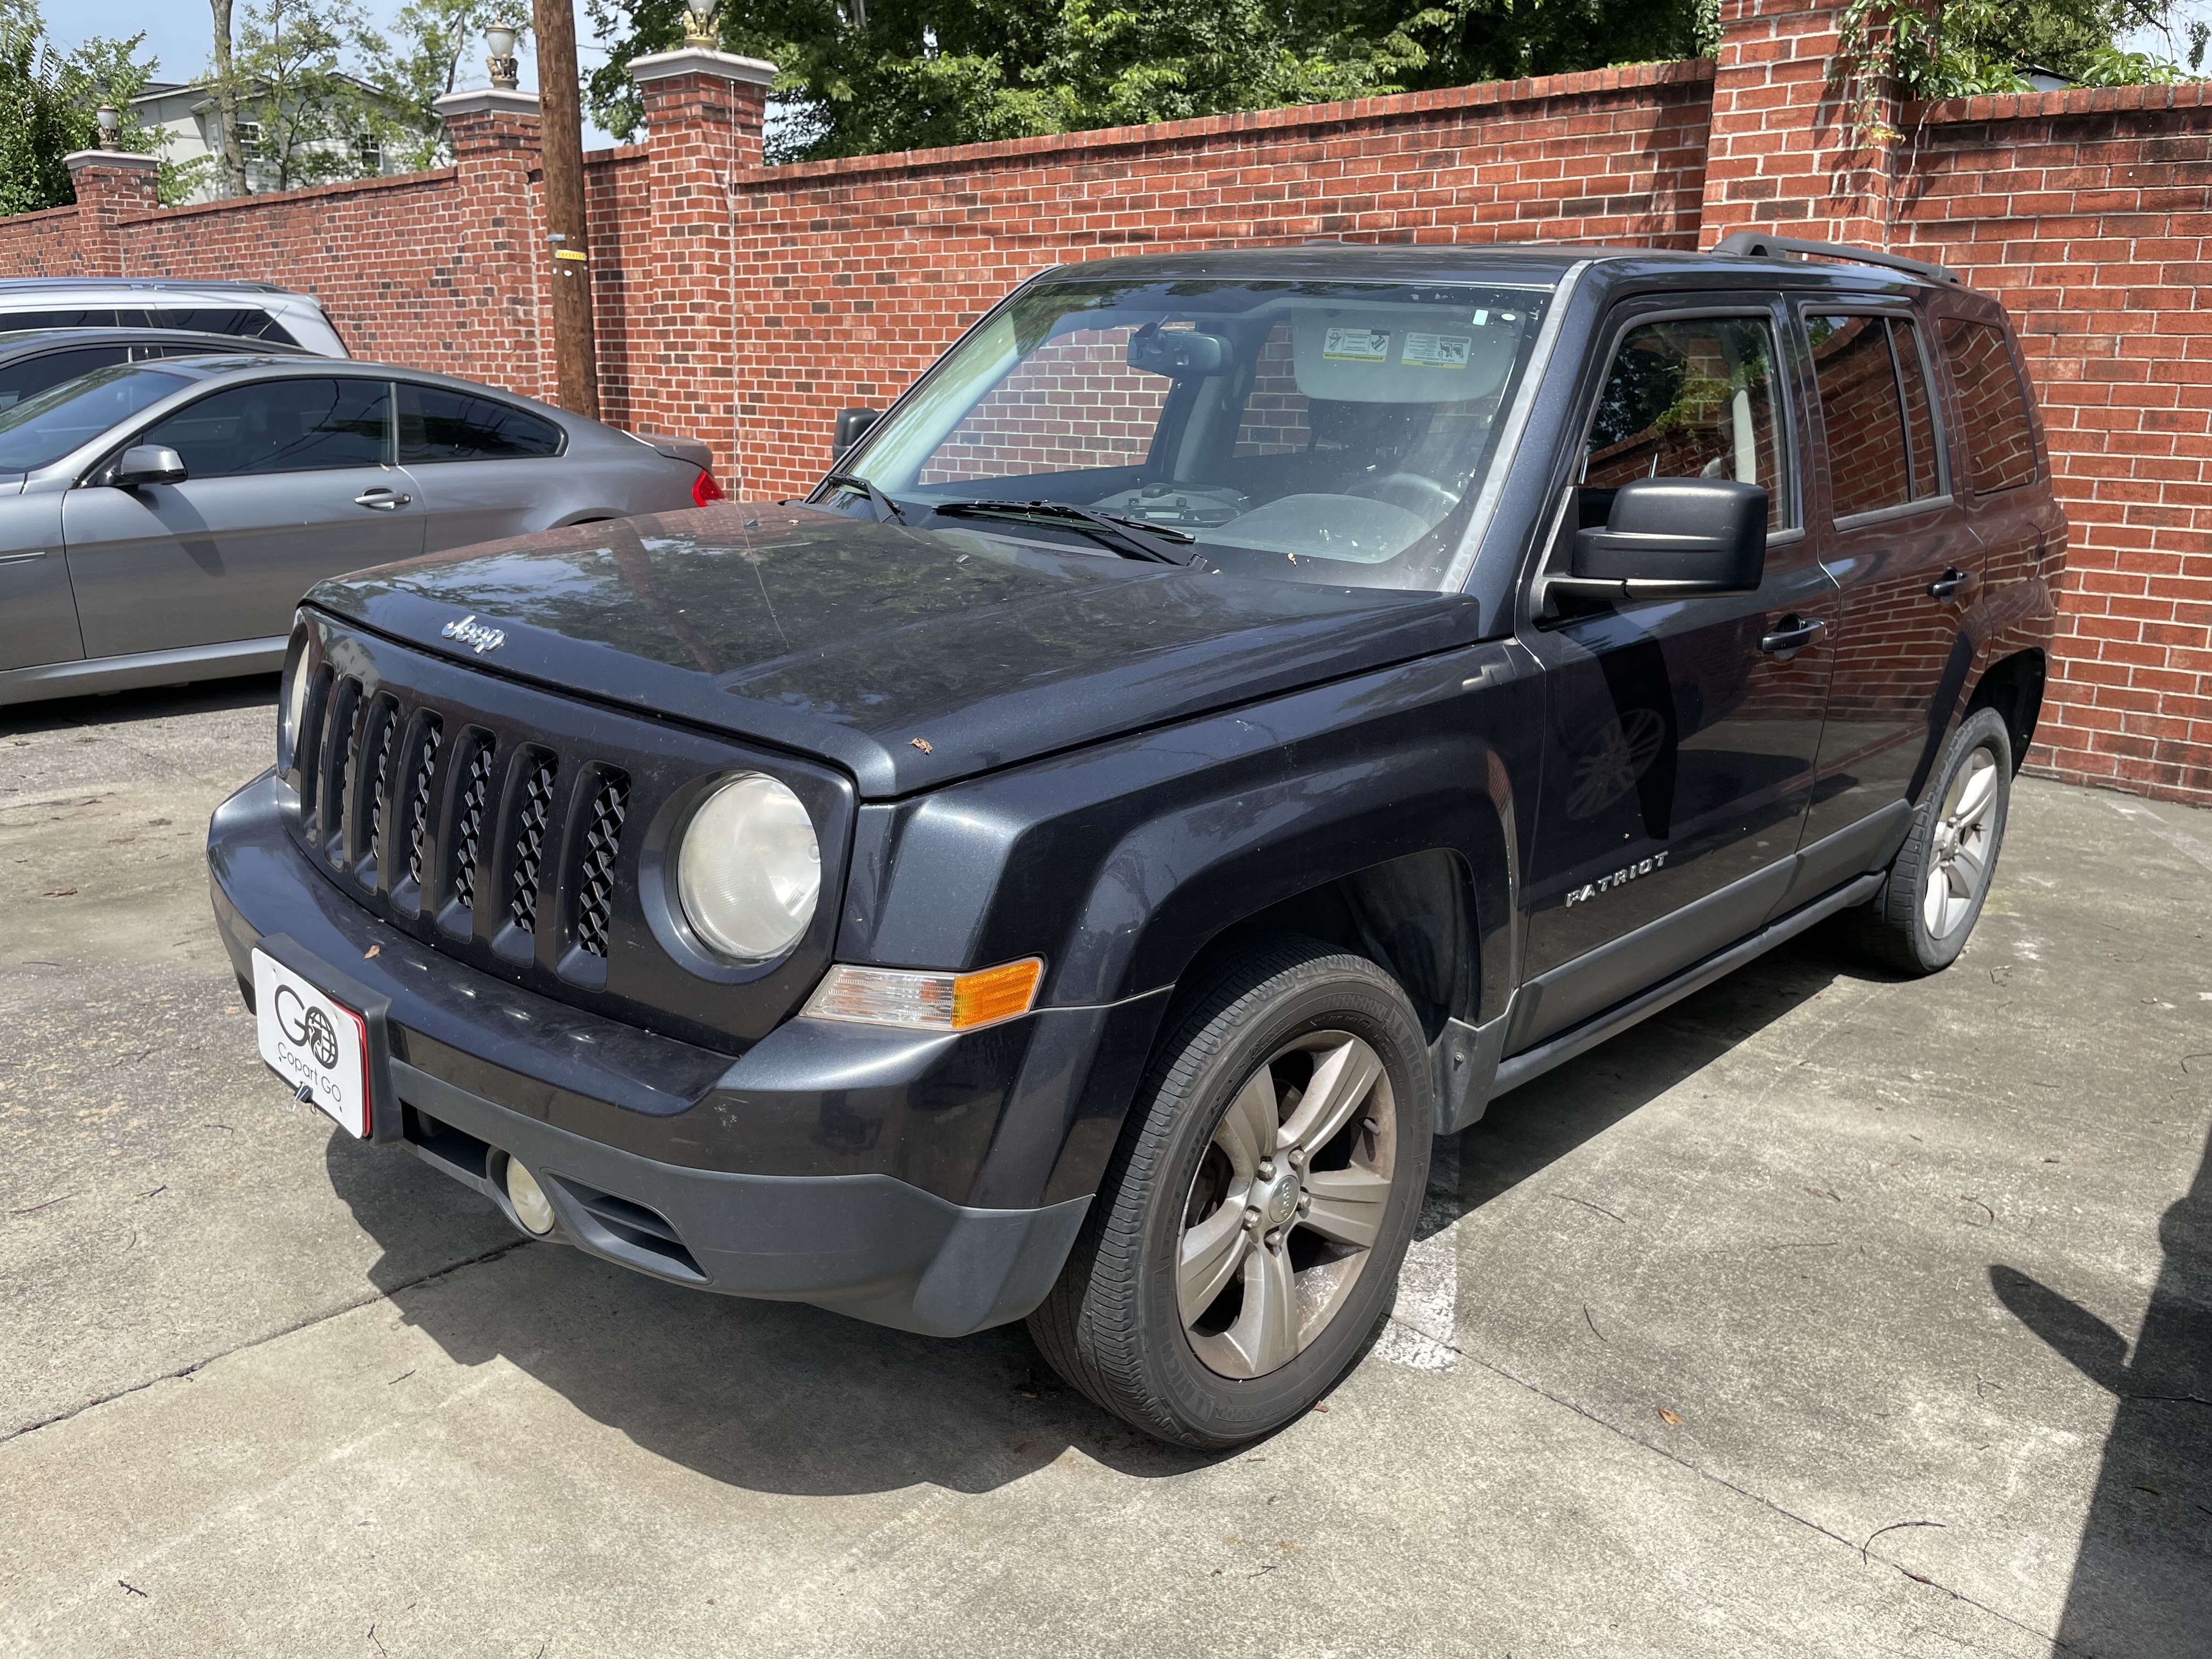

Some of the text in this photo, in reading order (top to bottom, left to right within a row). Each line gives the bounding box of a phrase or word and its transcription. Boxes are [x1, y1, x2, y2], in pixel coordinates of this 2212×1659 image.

[442, 614, 505, 654] Jeep
[1565, 850, 1669, 907] PATRIOT
[278, 1042, 342, 1102] Copart GO
[1401, 1031, 1428, 1154] MICHELIN
